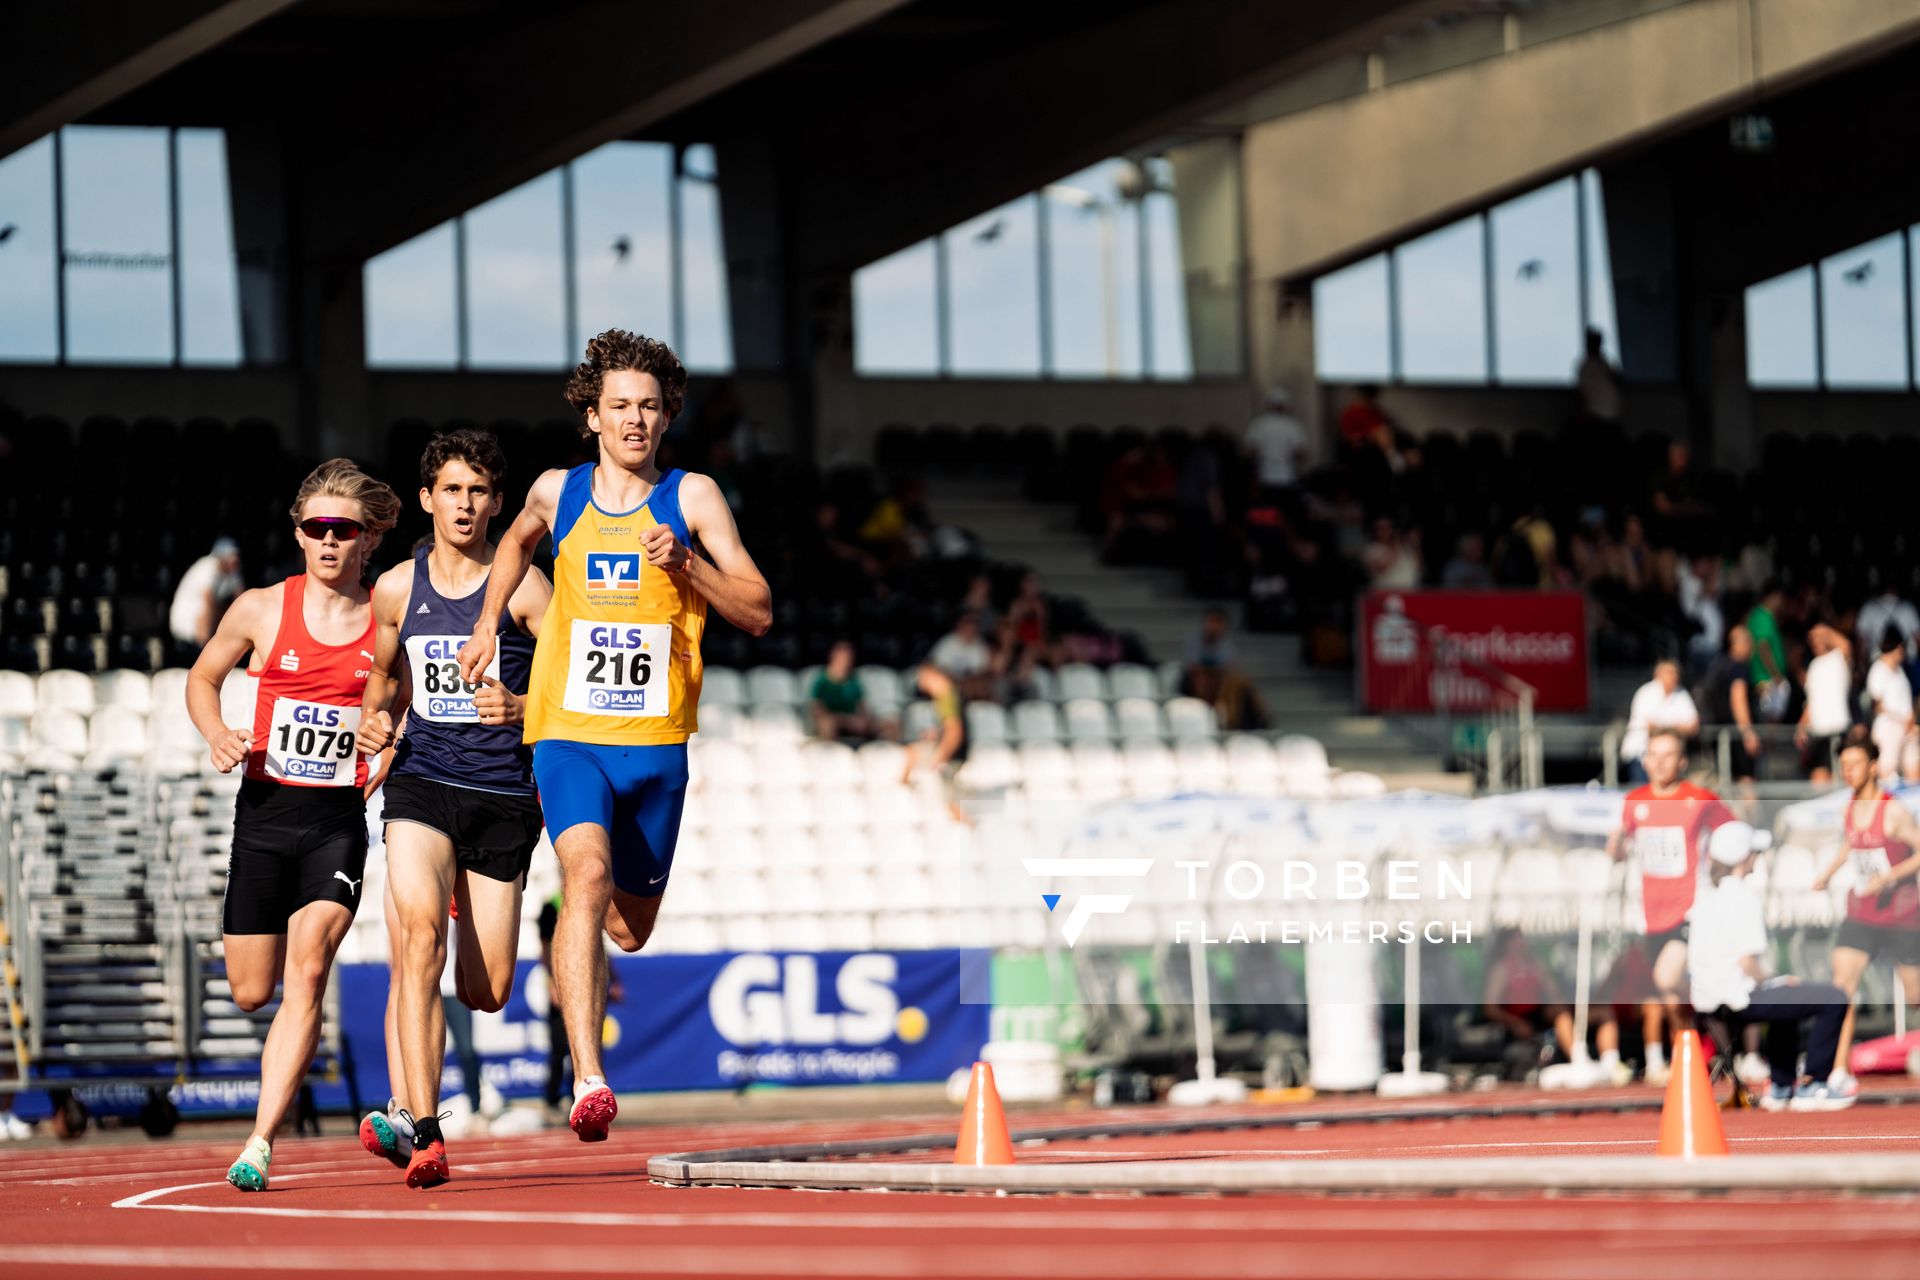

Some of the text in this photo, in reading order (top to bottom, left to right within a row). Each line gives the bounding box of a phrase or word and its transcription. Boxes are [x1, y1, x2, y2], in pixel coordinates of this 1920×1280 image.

[586, 650, 651, 686] 216
[610, 693, 643, 704] PLAN
[447, 701, 477, 710] PLAN
[278, 724, 355, 759] 1079
[306, 763, 335, 774] PLAN
